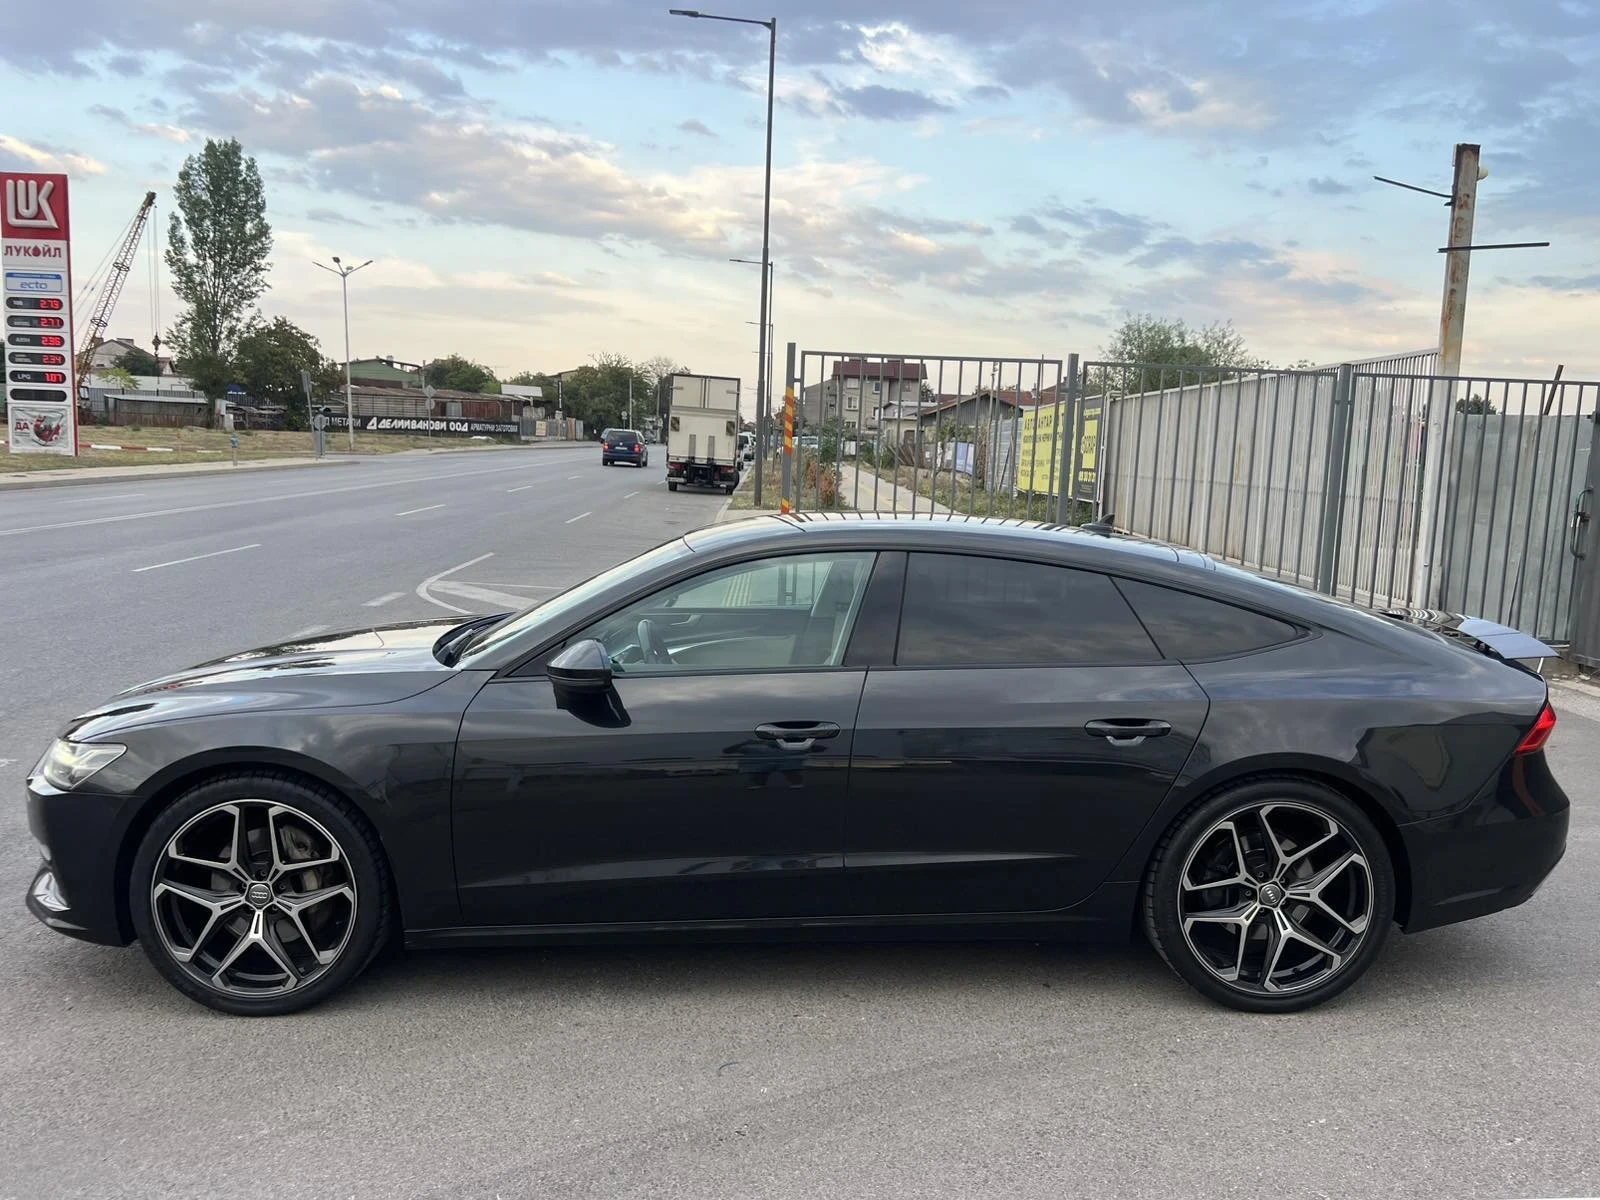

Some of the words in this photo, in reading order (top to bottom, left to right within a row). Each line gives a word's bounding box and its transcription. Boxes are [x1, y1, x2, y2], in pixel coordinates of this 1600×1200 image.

[4, 244, 62, 258] ЛУКОЙЛ
[20, 281, 48, 290] ecto
[448, 421, 468, 432] ООД
